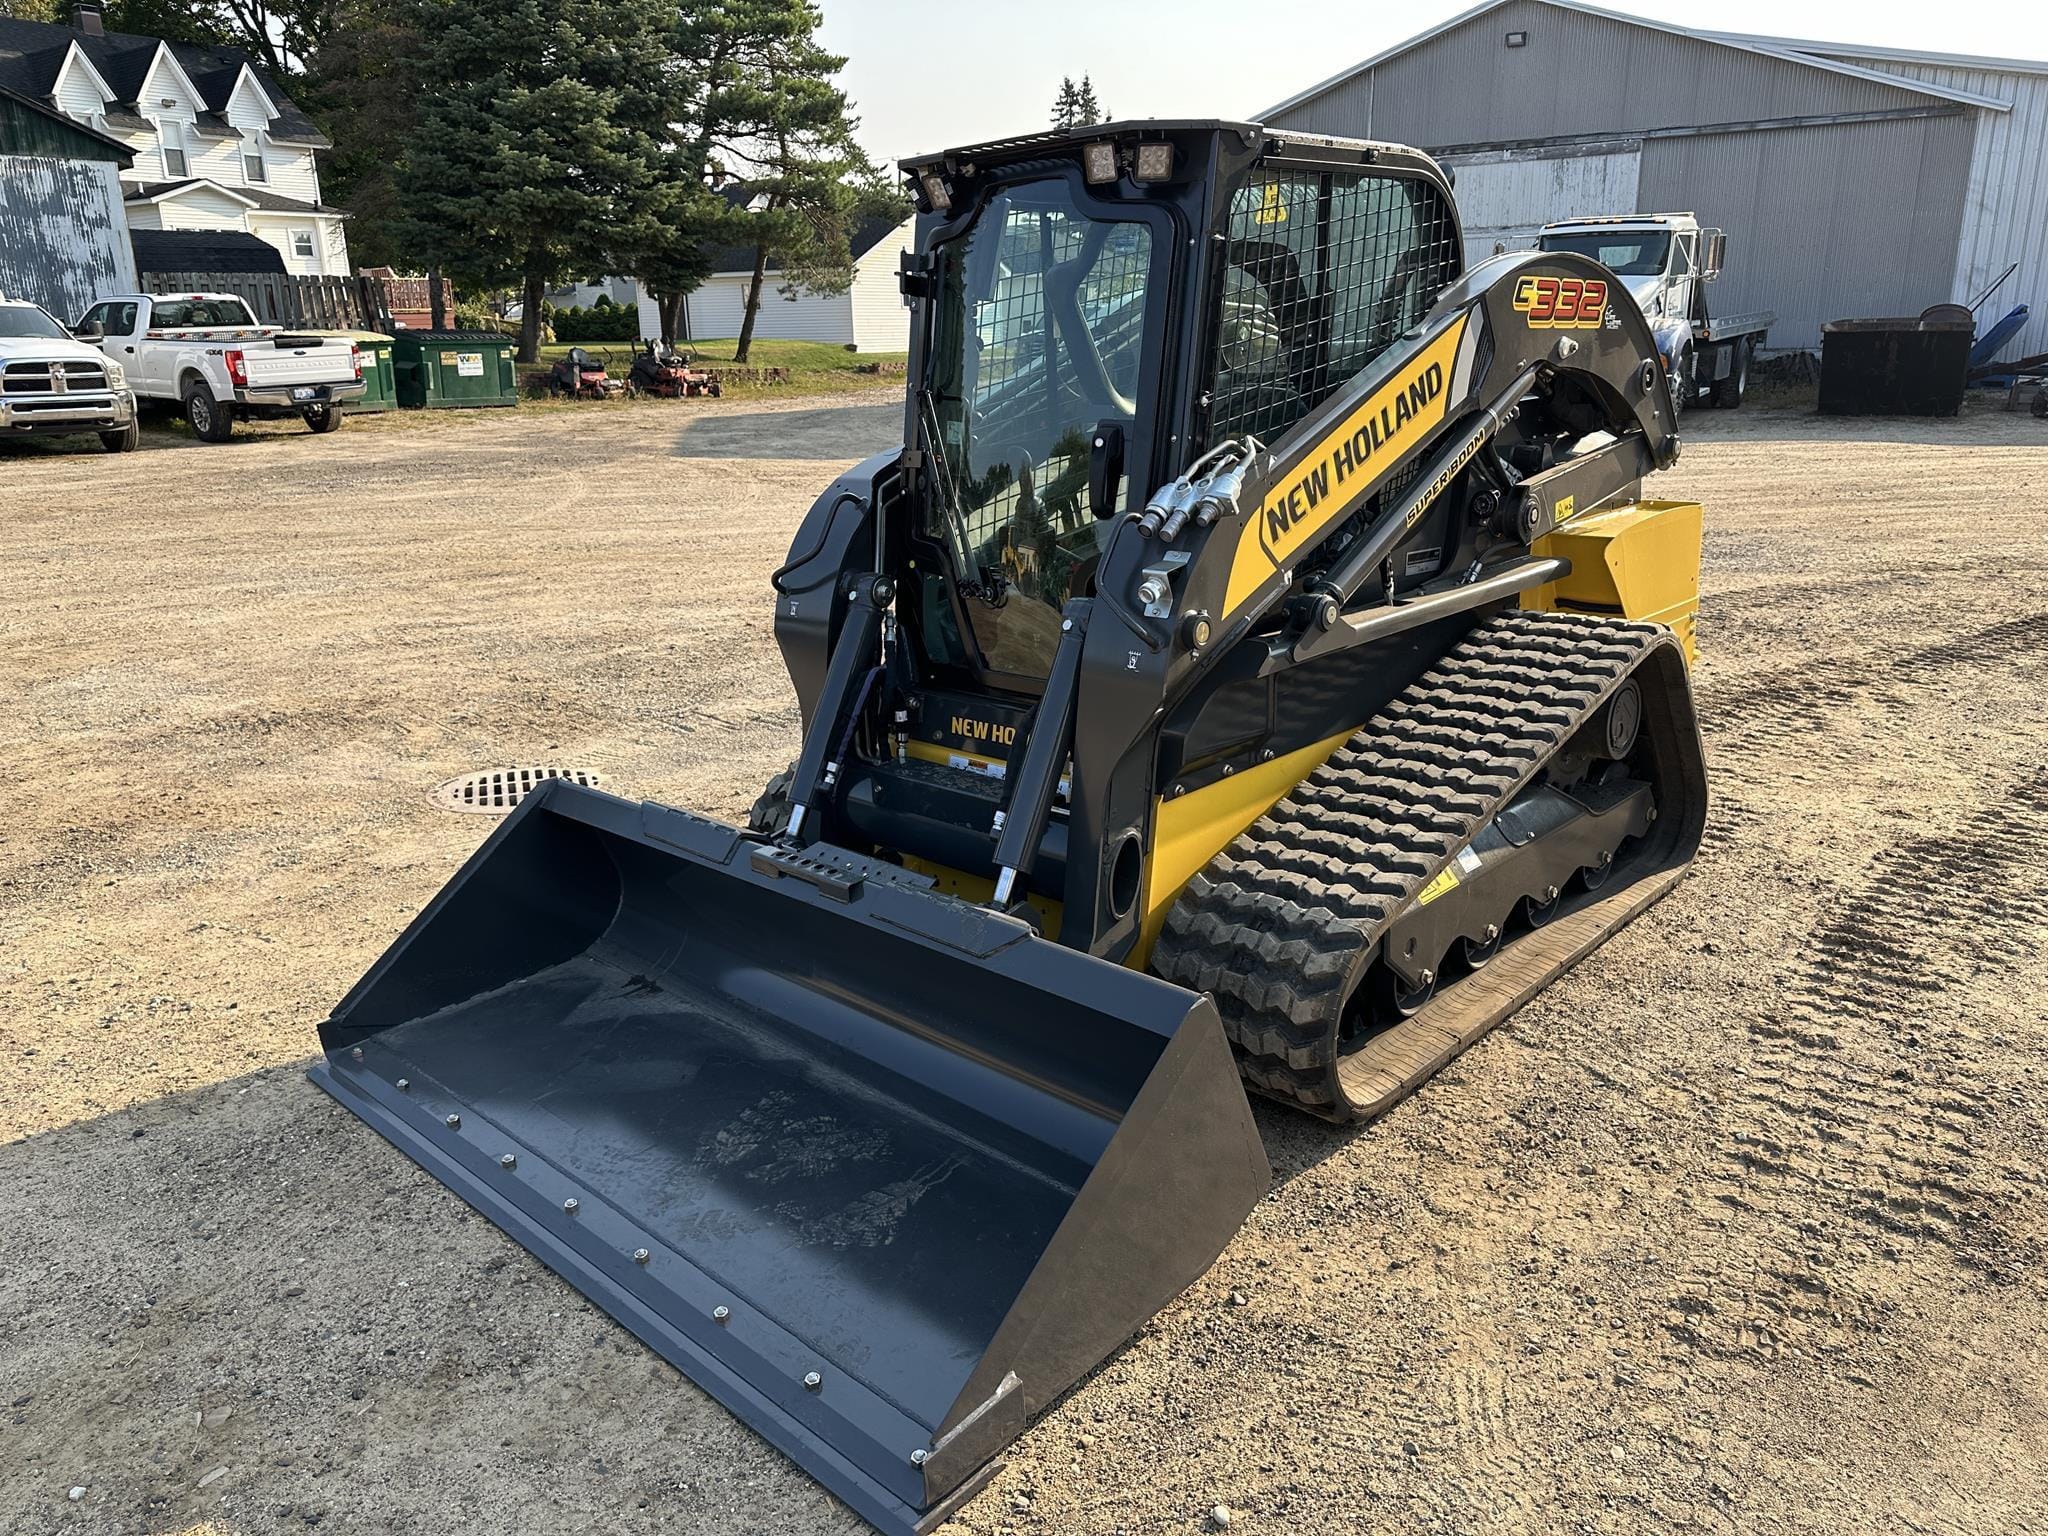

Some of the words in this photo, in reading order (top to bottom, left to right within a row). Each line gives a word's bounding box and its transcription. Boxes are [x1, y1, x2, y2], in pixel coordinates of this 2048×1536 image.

[1266, 461, 1329, 545] NEW
[1333, 361, 1442, 485] HOLLAND
[1406, 469, 1449, 527] SUPER
[1450, 428, 1485, 478] BOOM
[951, 716, 989, 740] NEW
